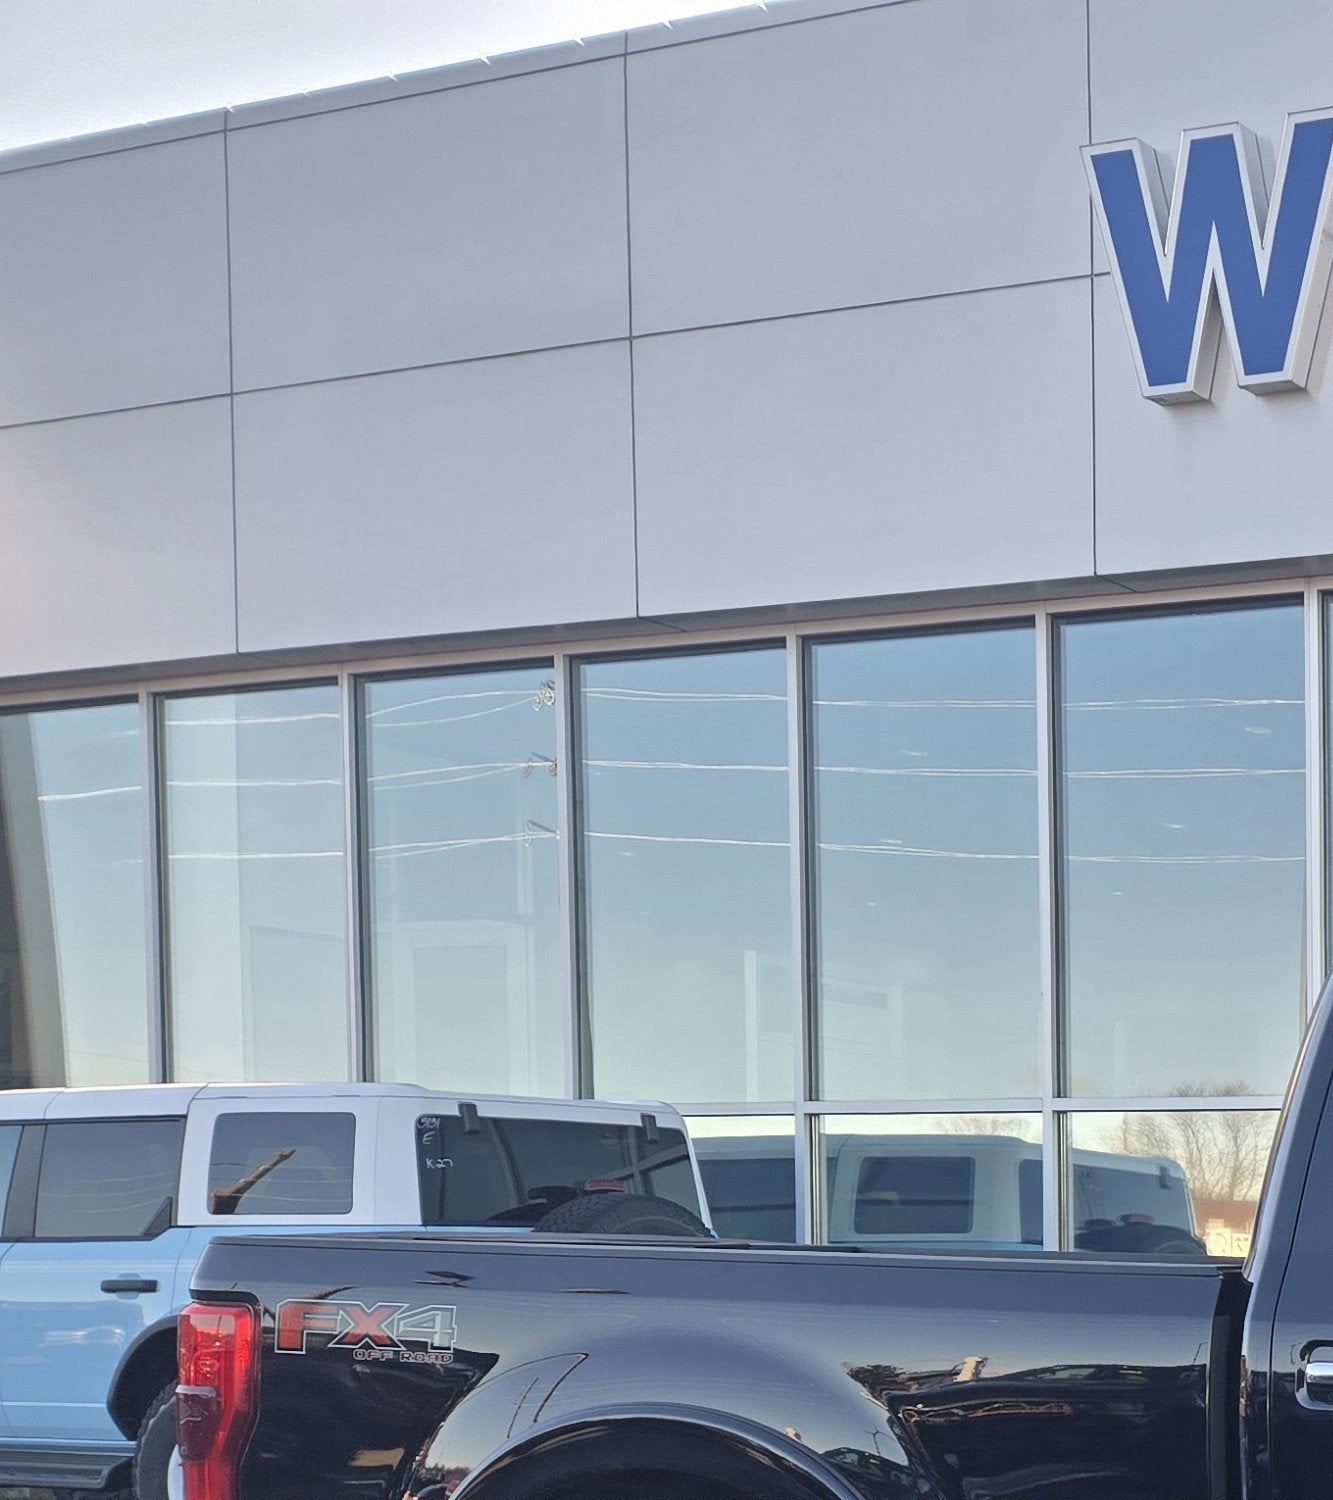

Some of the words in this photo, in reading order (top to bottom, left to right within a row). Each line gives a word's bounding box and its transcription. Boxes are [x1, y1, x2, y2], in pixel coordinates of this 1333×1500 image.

[275, 1299, 457, 1354] FX4
[353, 1349, 394, 1361] OFF
[400, 1351, 454, 1364] ROAD
